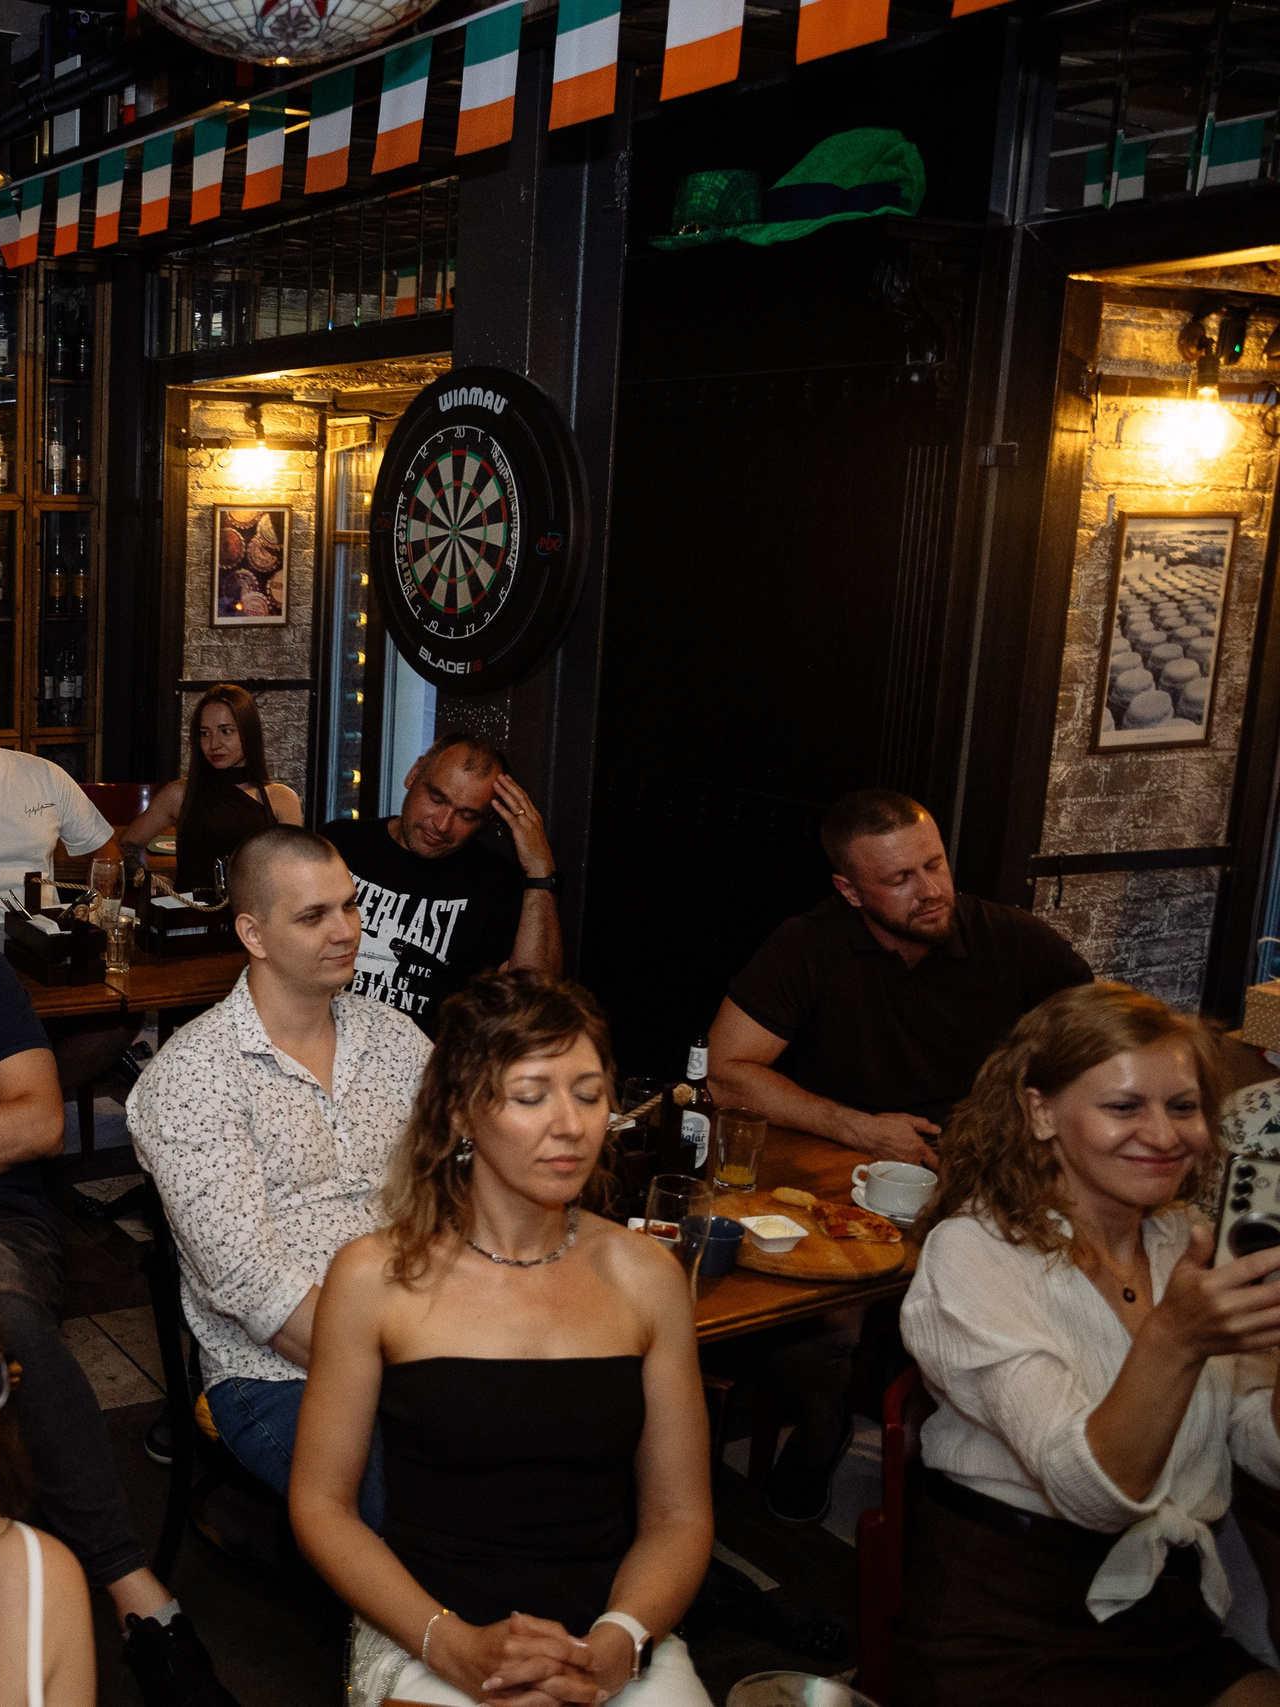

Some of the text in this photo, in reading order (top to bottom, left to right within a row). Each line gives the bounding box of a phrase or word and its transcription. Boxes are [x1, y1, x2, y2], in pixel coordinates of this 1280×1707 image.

[437, 386, 508, 415] WINMAU
[454, 426, 466, 438] 20
[398, 513, 419, 601] Larsen
[428, 620, 439, 633] 19
[407, 963, 432, 979] NYC
